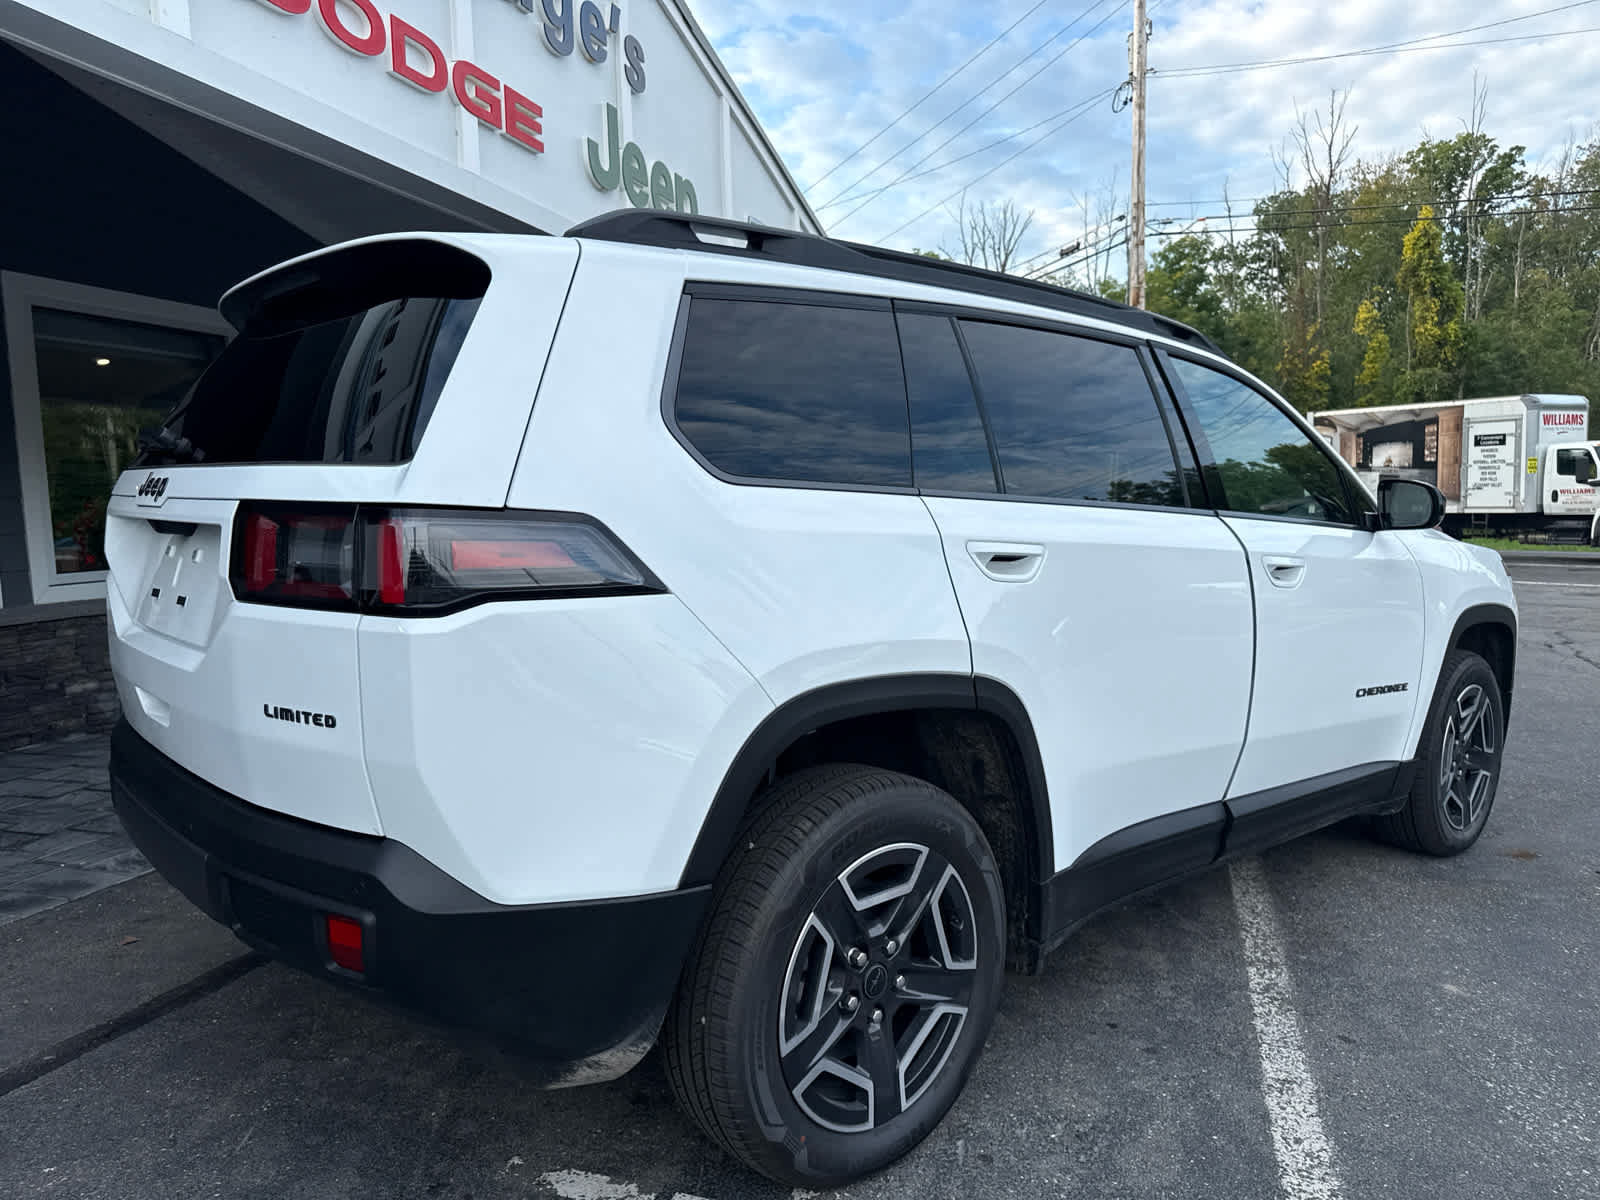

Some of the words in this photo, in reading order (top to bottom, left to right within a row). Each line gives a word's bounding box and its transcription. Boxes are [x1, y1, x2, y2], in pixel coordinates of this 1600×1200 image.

[508, 0, 646, 94] ge's
[236, 0, 545, 155] ODGE
[1542, 414, 1584, 426] WILLIAMS
[138, 471, 169, 502] Jeep
[1355, 682, 1408, 698] CHEROKEE
[263, 703, 337, 728] LIMITED
